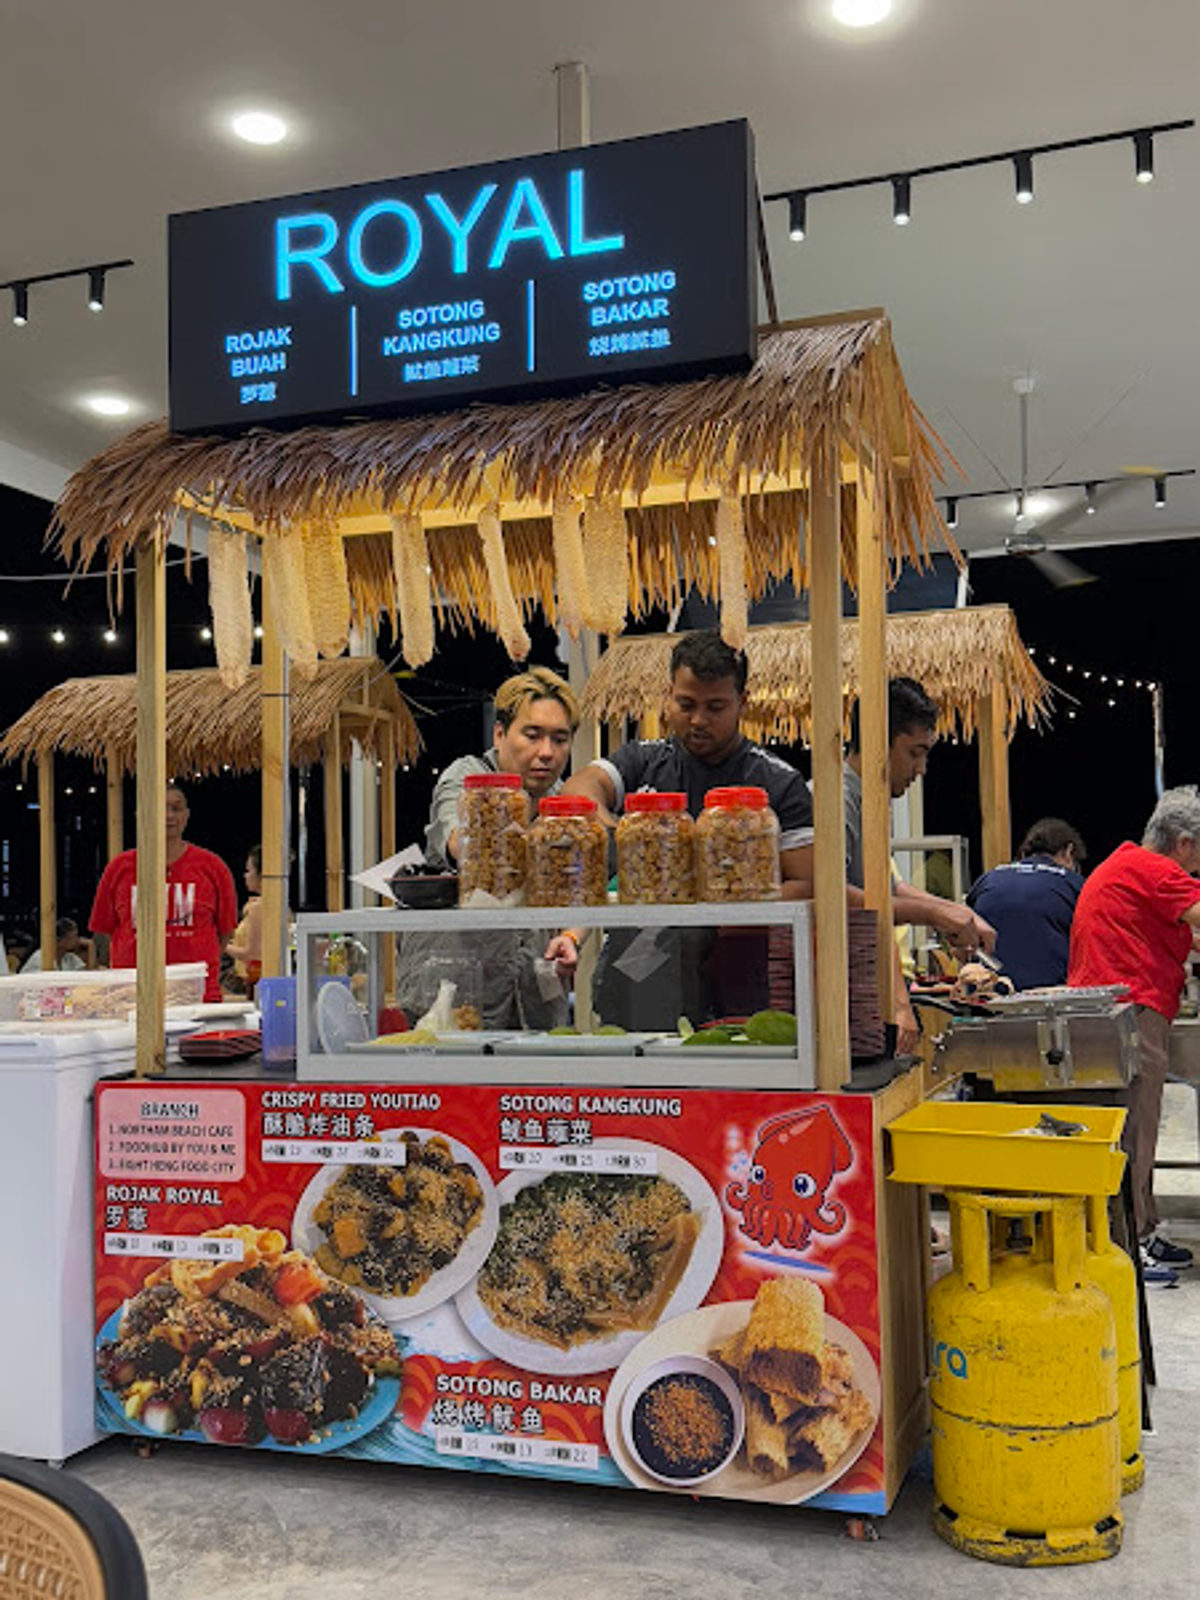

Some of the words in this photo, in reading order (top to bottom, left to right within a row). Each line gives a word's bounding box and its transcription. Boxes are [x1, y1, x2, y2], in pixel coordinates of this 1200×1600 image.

[276, 169, 625, 300] ROYAL
[583, 270, 676, 302] SOTONG
[398, 299, 485, 329] SOTONG
[590, 298, 670, 327] BAKAR
[225, 326, 292, 354] ROJAK
[383, 322, 500, 356] KANGKUNG
[231, 352, 287, 378] BUAH
[141, 1103, 199, 1117] BRANCH
[261, 1091, 316, 1108] CRISPY
[320, 1092, 366, 1109] FRIED
[371, 1093, 441, 1111] YOUTIAO
[500, 1095, 574, 1113] SOTONG
[578, 1096, 682, 1116] KANGKUNG
[106, 1185, 161, 1203] ROJAK
[165, 1187, 223, 1206] ROYAL
[436, 1374, 523, 1400] SOTONG
[529, 1381, 602, 1406] BAKAR
